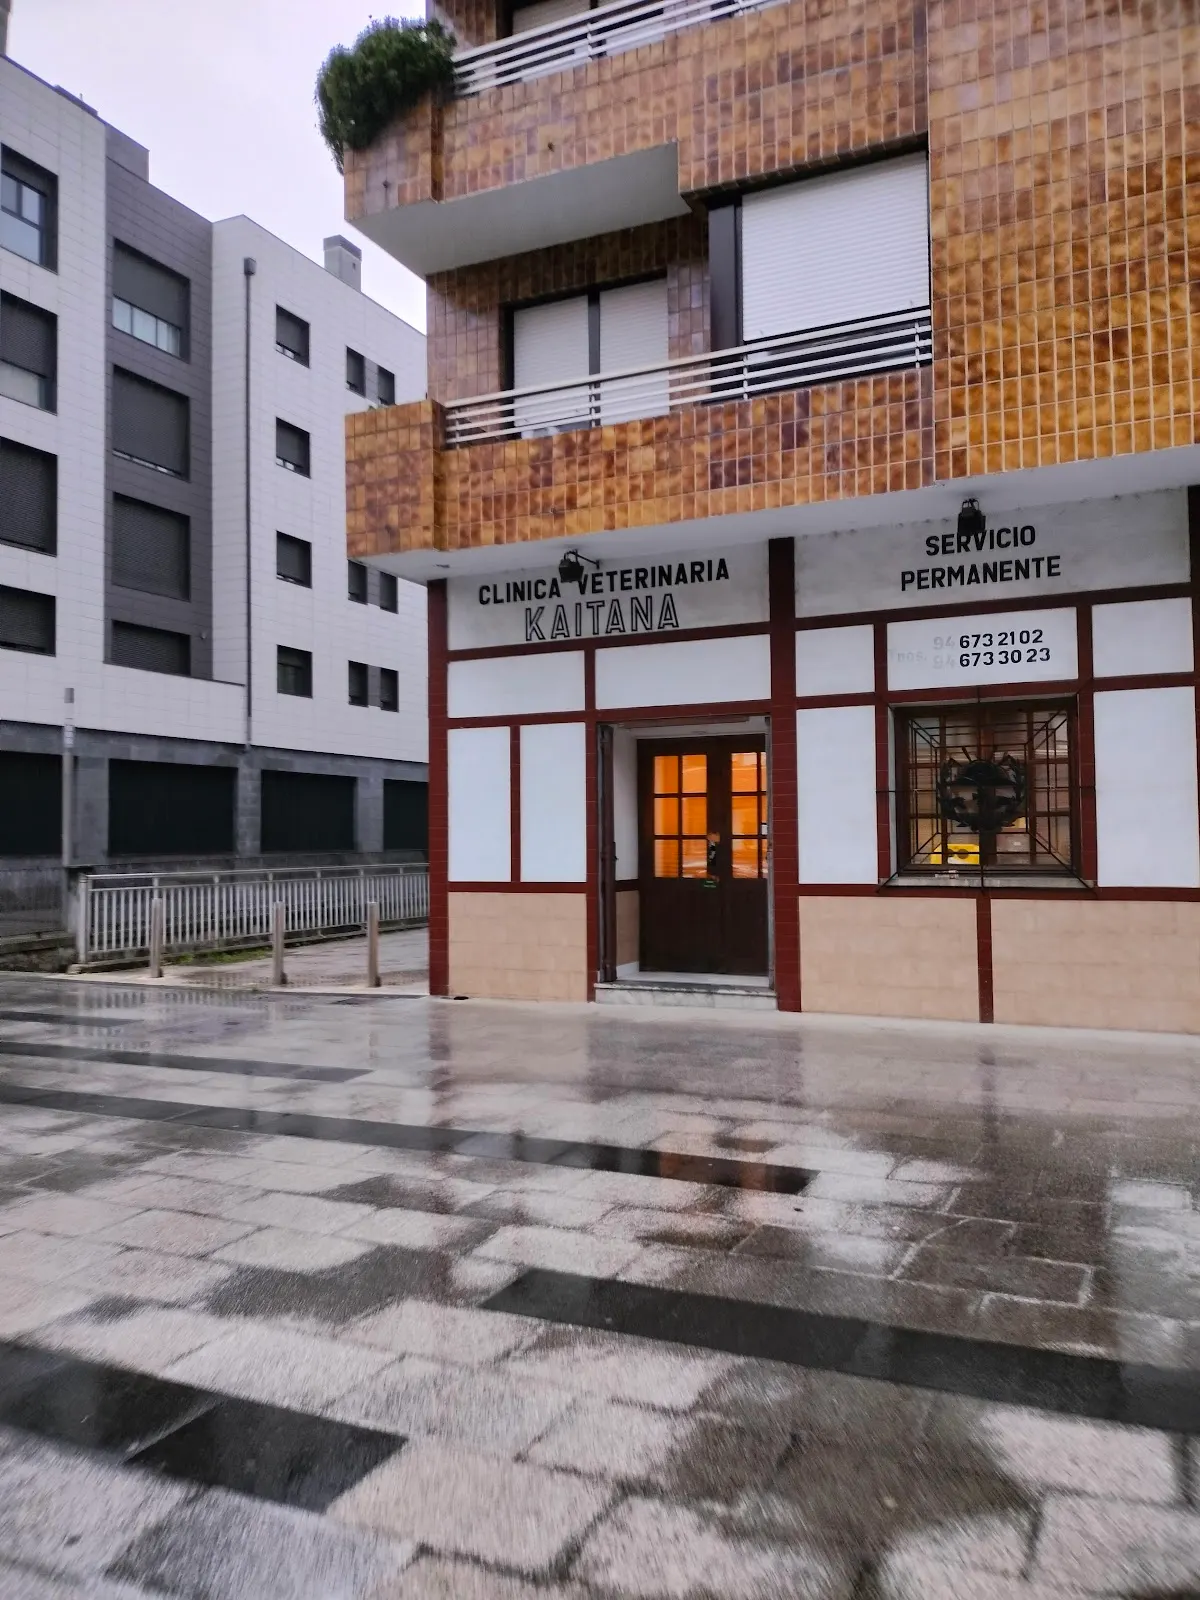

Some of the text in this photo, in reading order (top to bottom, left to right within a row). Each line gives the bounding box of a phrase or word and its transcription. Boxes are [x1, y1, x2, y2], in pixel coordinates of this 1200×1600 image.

[925, 525, 1036, 556] SERVICIO
[479, 558, 730, 605] CLINICA VETERINARIA
[901, 555, 1061, 592] PERMANENTE
[524, 593, 680, 641] KAITANA
